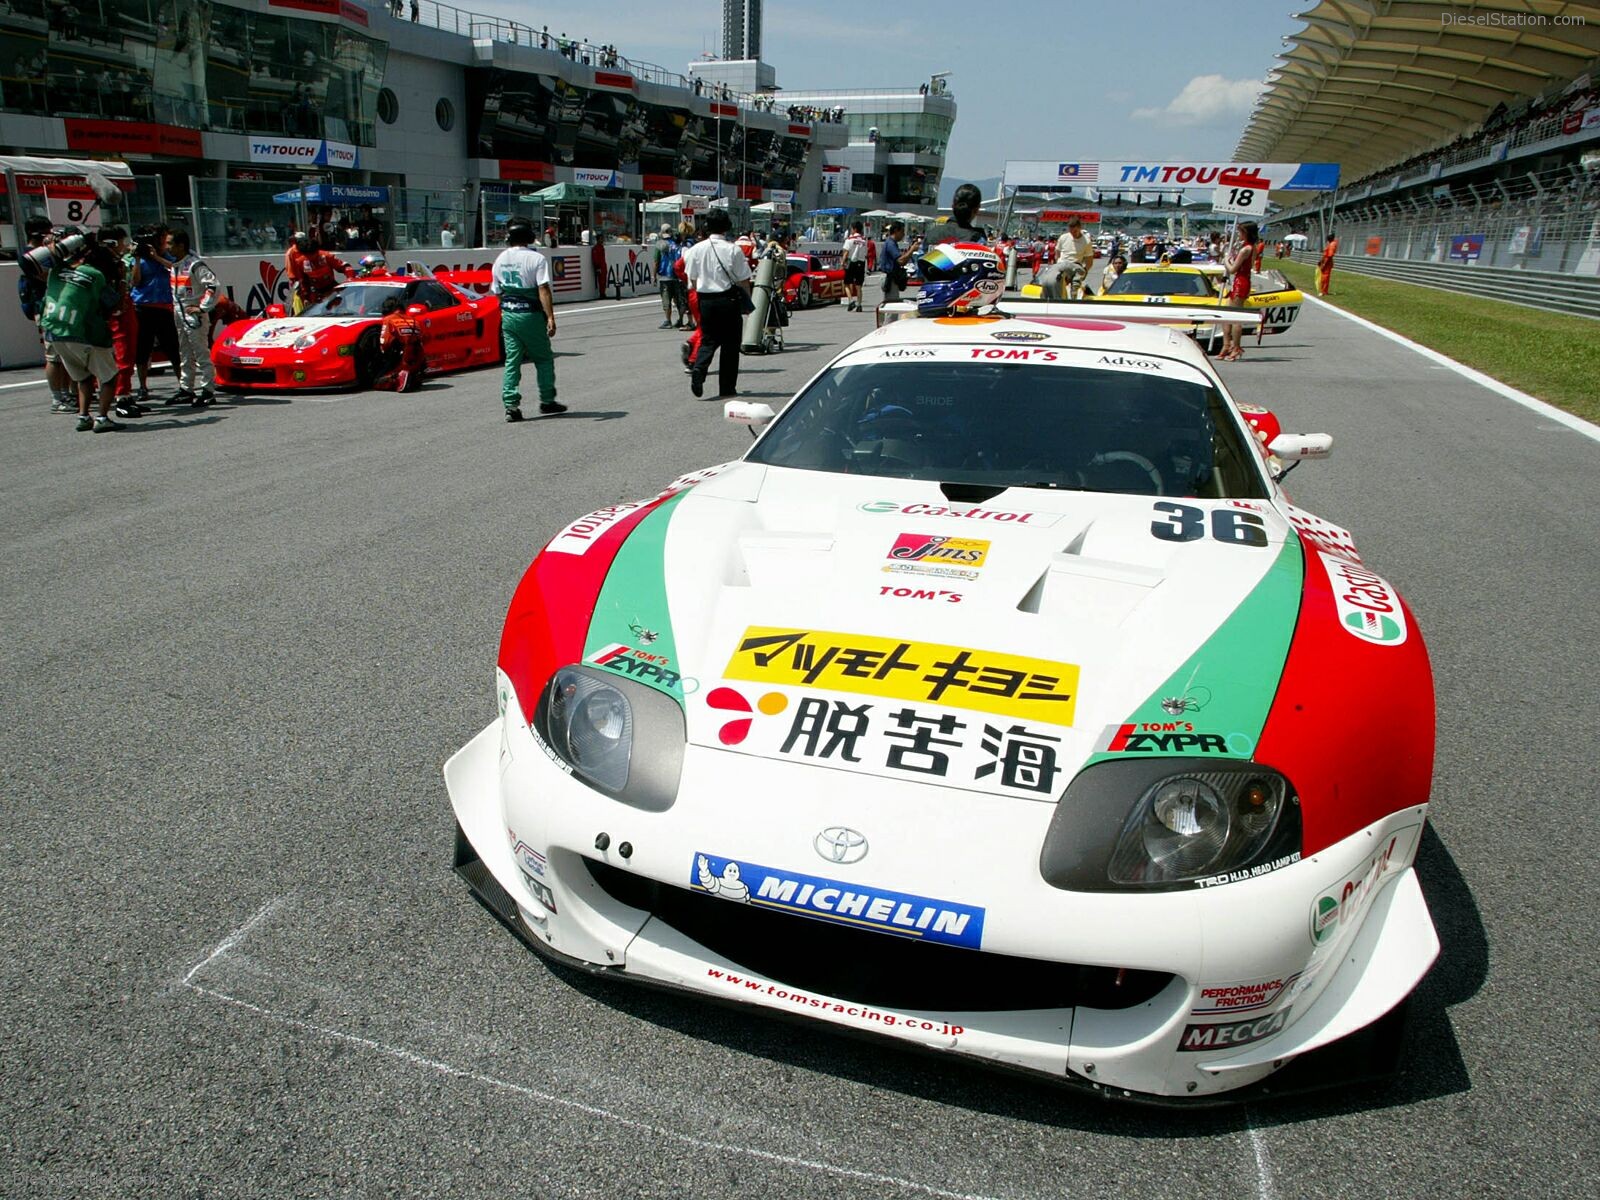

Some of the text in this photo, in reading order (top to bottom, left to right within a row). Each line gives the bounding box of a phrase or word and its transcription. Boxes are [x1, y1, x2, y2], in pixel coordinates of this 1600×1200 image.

[252, 144, 315, 157] TMTOUCH
[327, 148, 354, 161] TMTOUCH
[575, 172, 609, 182] TMTOUCH
[1120, 165, 1261, 184] TMTOUCH
[1228, 188, 1255, 207] 18
[68, 201, 83, 222] 8
[880, 349, 937, 358] Advox
[970, 349, 1059, 361] TOM'S
[1098, 355, 1162, 370] Advox
[901, 503, 1034, 524] Castrol
[1151, 501, 1268, 547] 36
[880, 586, 963, 603] TOM'S
[632, 650, 669, 666] TOM'S
[739, 632, 1071, 701] マツモトキヨシ
[1141, 721, 1193, 732] TOM'S
[780, 697, 1062, 794] 脱苦海
[1194, 874, 1229, 888] TRD
[1251, 862, 1272, 876] HEAD
[1271, 855, 1291, 869] LAMP
[1290, 851, 1301, 863] KIT
[757, 877, 971, 936] MICHELIN
[1200, 979, 1284, 999] PERFORMANCE
[707, 968, 964, 1036] www.tomsracing.co.jp
[1215, 993, 1266, 1007] FRICTION
[1184, 1013, 1285, 1047] MECCA
